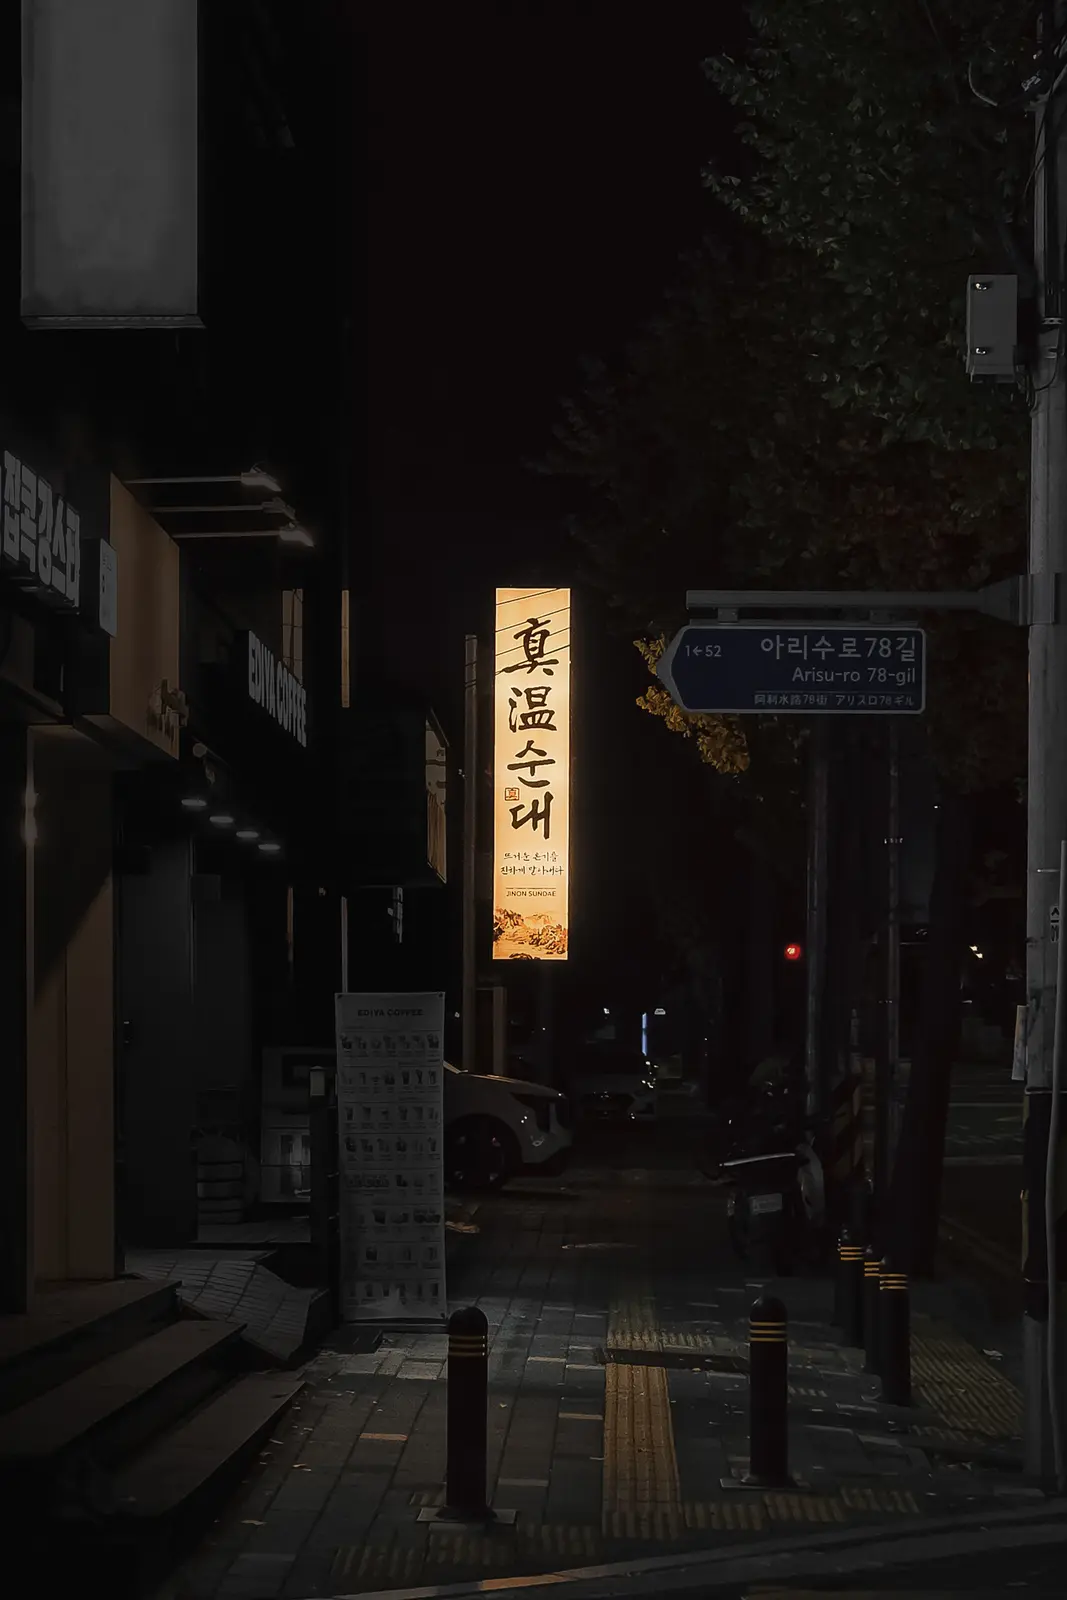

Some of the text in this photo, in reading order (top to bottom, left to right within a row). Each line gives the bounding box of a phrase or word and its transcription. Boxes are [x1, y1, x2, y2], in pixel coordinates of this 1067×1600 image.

[760, 634, 916, 662] 아리수로78길
[248, 630, 307, 748] EDIYA COFFEE
[792, 666, 916, 686] Arisu-ro 78-gil
